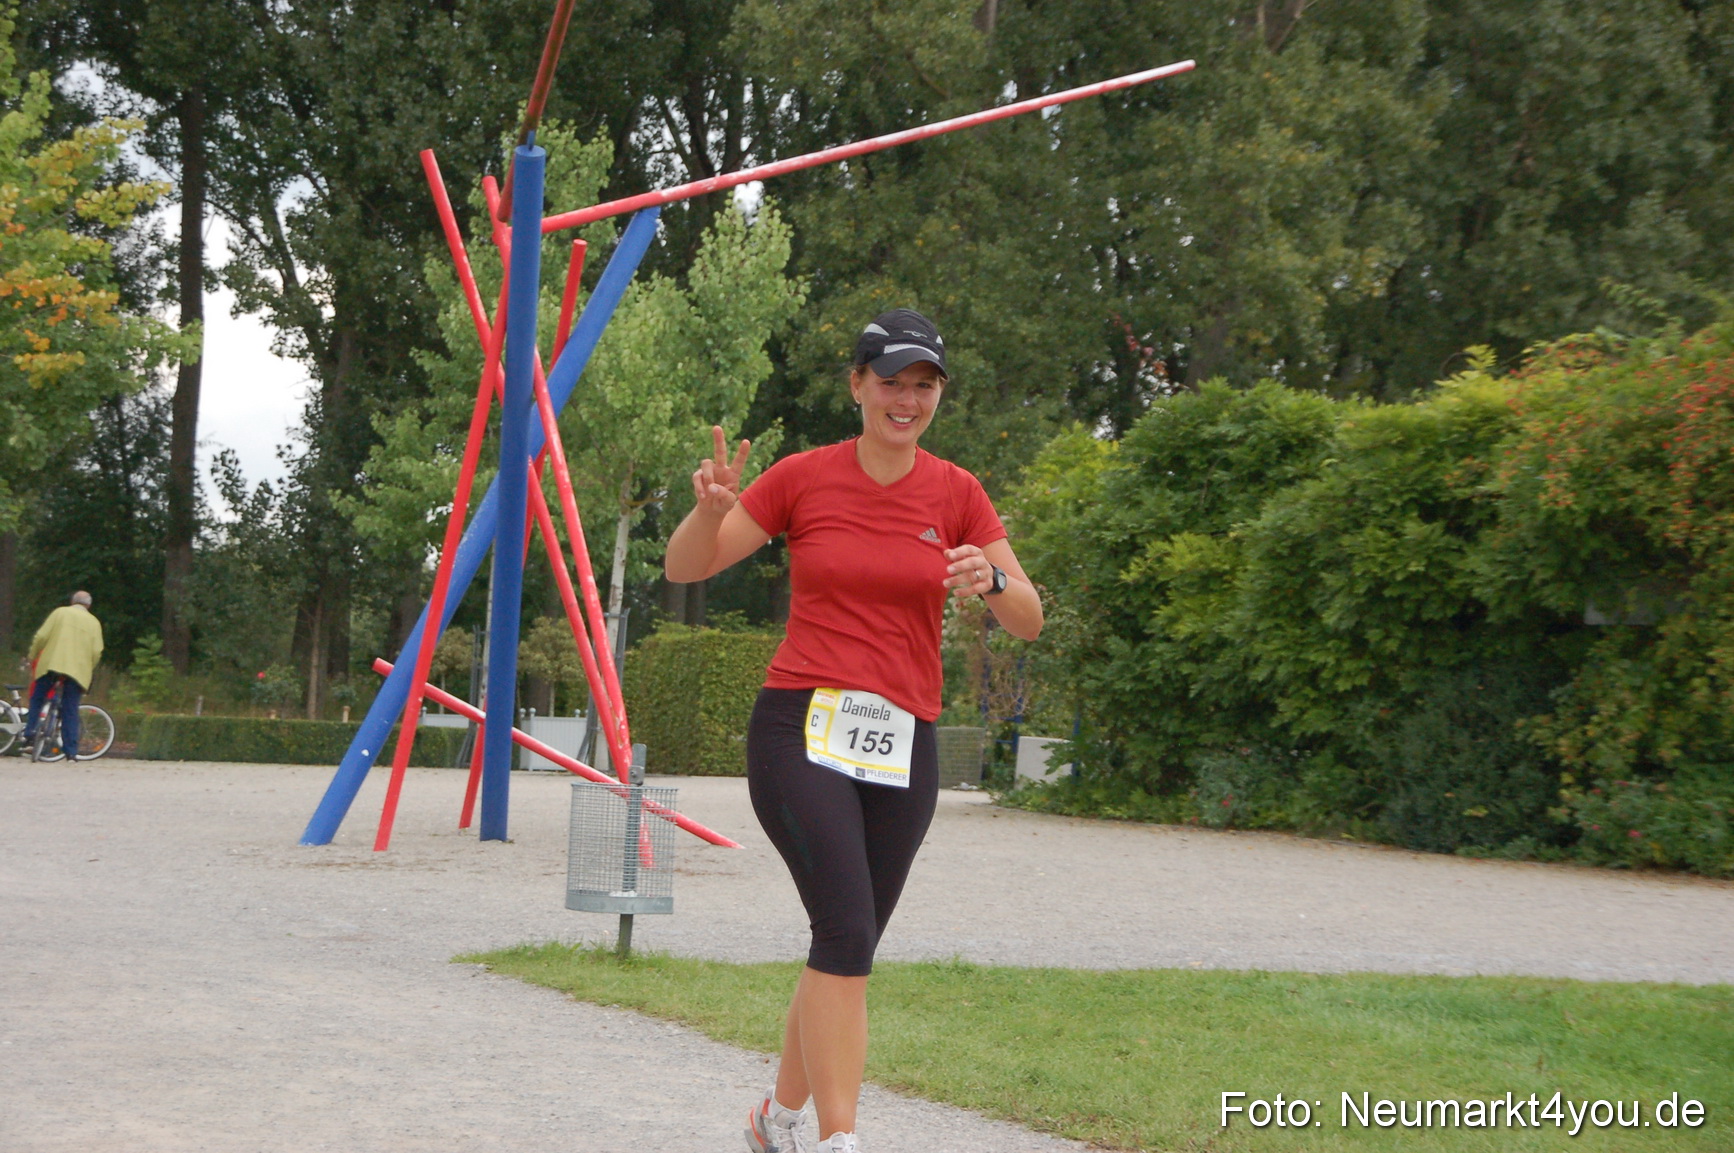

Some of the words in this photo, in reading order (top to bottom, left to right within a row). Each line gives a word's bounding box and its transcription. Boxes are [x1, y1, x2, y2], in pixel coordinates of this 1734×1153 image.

[841, 696, 891, 721] Daniela
[811, 714, 819, 727] C
[847, 727, 895, 756] 155
[866, 768, 907, 782] PFLEIDERER
